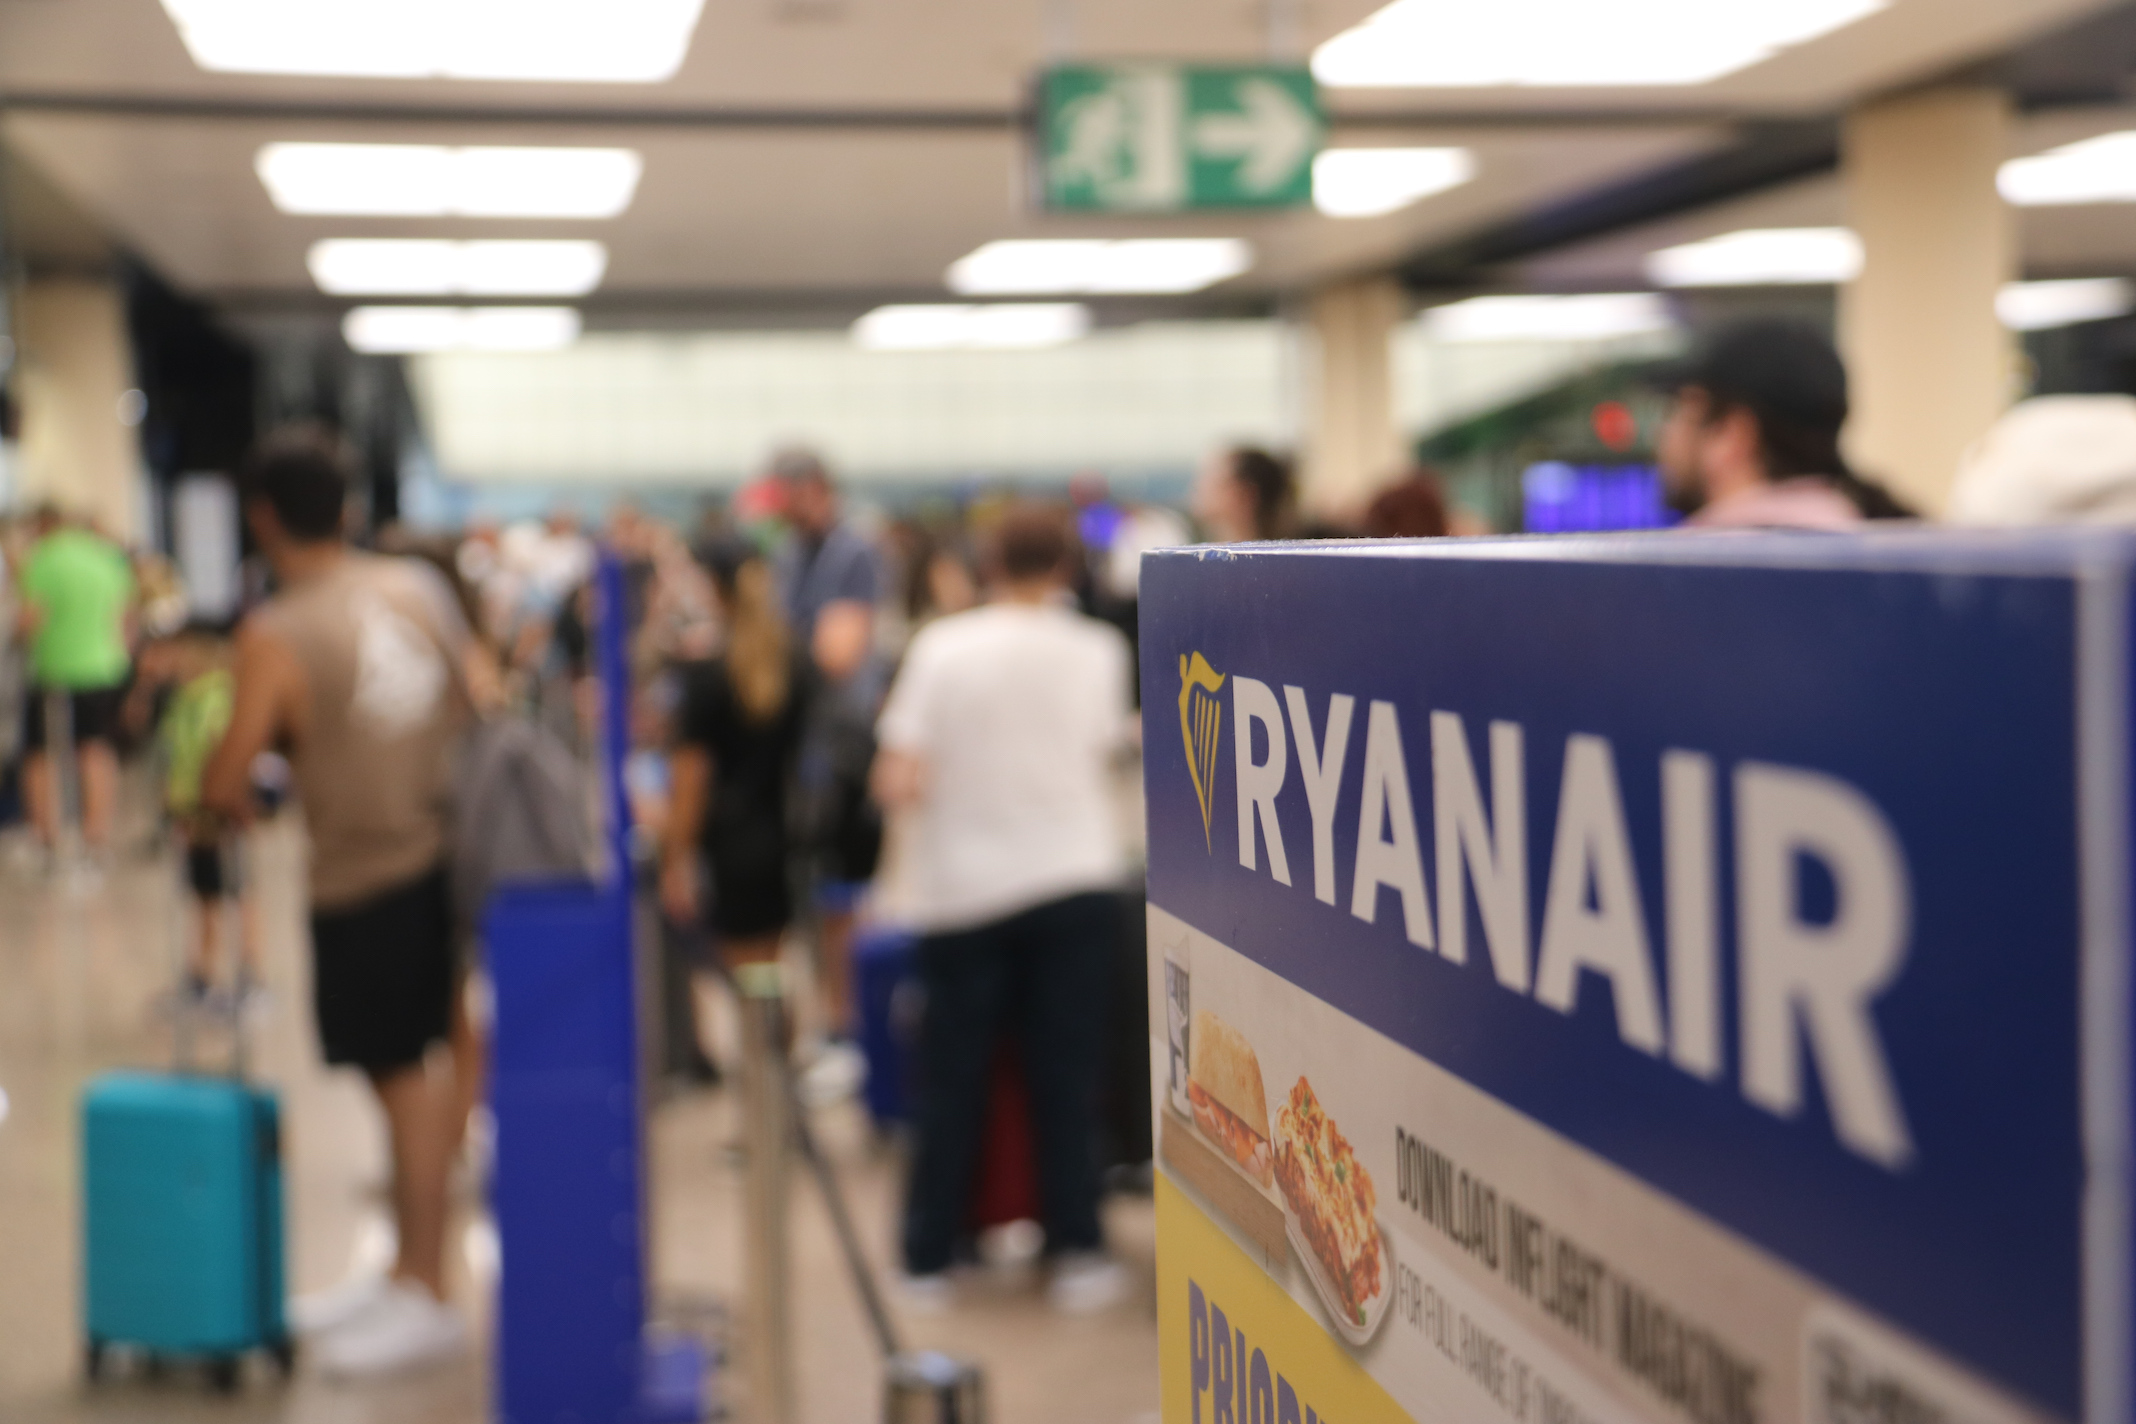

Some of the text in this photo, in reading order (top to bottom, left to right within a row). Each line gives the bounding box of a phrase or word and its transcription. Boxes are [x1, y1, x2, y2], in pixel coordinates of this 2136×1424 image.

[1230, 673, 1917, 1172] RYANAIR
[1396, 1125, 1499, 1270] DOWNLOAD
[1400, 1262, 1423, 1334] FOR
[1425, 1281, 1458, 1364] FULL
